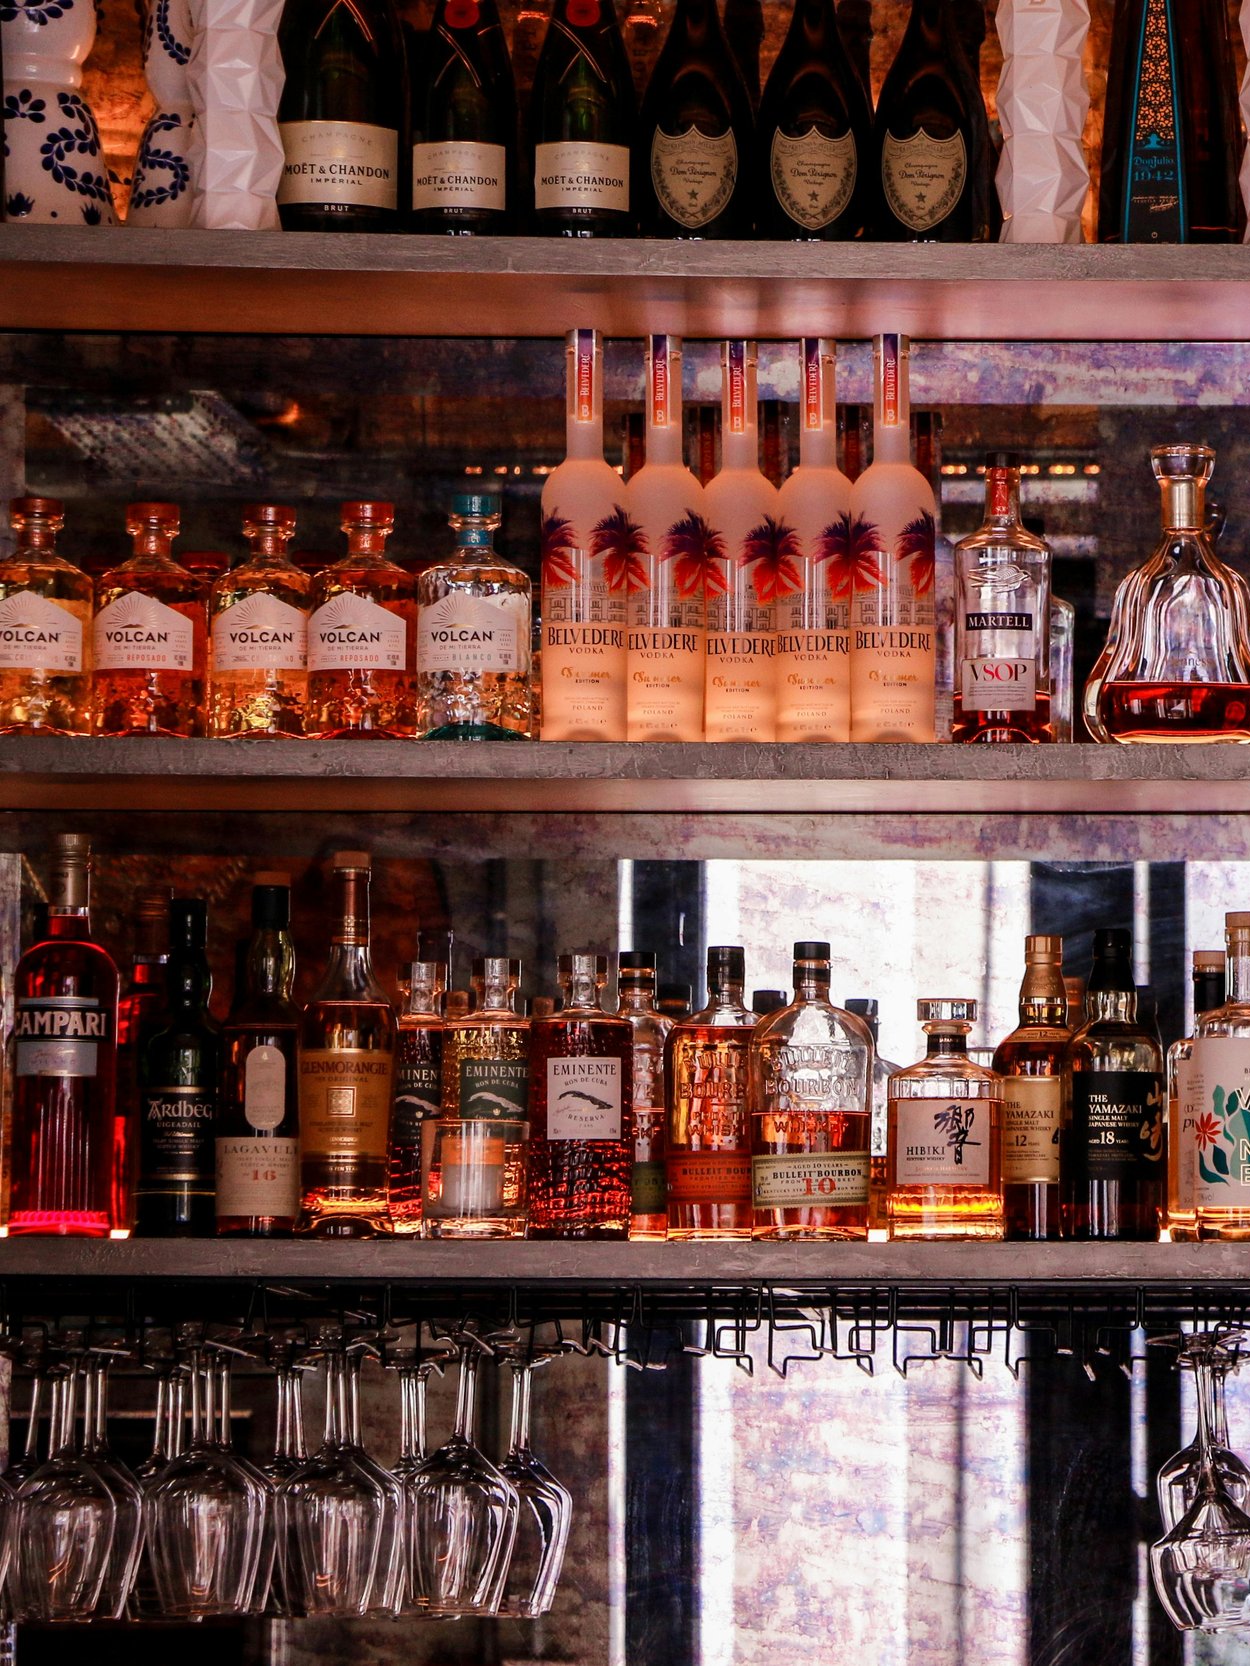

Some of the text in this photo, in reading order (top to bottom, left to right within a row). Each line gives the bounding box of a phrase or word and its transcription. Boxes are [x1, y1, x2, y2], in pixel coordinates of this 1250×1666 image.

[285, 162, 390, 181] MOËT CHANDON
[669, 167, 688, 176] Dom
[790, 168, 808, 178] Dom
[899, 170, 917, 179] Dom
[1134, 169, 1175, 181] 1942
[416, 174, 498, 188] MOËT CHANDON
[541, 174, 624, 188] MOËT CHANDON
[323, 204, 350, 213] BRUT
[443, 207, 464, 215] BRUT
[572, 207, 593, 215] BRUT
[580, 353, 591, 397] BELVEDERE
[655, 358, 665, 402] BELVEDERE
[885, 357, 895, 400] BELVEDERE
[731, 365, 742, 408] BELVEDERE
[808, 361, 818, 404] BELVEDERE
[968, 615, 1030, 629] MARTELL
[106, 631, 169, 643] VOLCAN
[229, 631, 293, 643] VOLCAN
[320, 631, 381, 644] VOLCAN
[431, 630, 493, 643] VOLCAN
[548, 626, 624, 649] BELVEDERE
[855, 630, 931, 653] BELVEDERE
[628, 633, 699, 653] ELVEDERE
[707, 638, 776, 657] ELVEDERE
[569, 647, 604, 655] VODKA
[640, 651, 675, 659] VODKA
[876, 650, 911, 658] VODKA
[126, 654, 167, 663] REPOSADO
[339, 654, 380, 663] REPOSADO
[452, 653, 493, 662] BLANCO
[719, 656, 754, 664] VODKA
[970, 663, 1028, 682] VSOP
[301, 1061, 389, 1075] GLENMORANGIE
[466, 1065, 530, 1078] EMINENTE
[553, 1064, 617, 1076] EMINENTE
[765, 1078, 859, 1096] BOURBON
[1088, 1094, 1108, 1103] THE
[1005, 1101, 1021, 1109] THE
[1088, 1103, 1143, 1114] YAMAZAKI
[1005, 1110, 1054, 1119] YAMAZAKI
[1014, 1135, 1027, 1147] 12
[1100, 1131, 1115, 1145] 18
[224, 1144, 298, 1154] LAGAVULI
[906, 1146, 945, 1156] HIBIKI
[252, 1169, 277, 1181] 16
[726, 1167, 751, 1175] BOUR
[772, 1169, 862, 1179] BULLEIT BOURBON
[802, 1177, 837, 1196] 10
